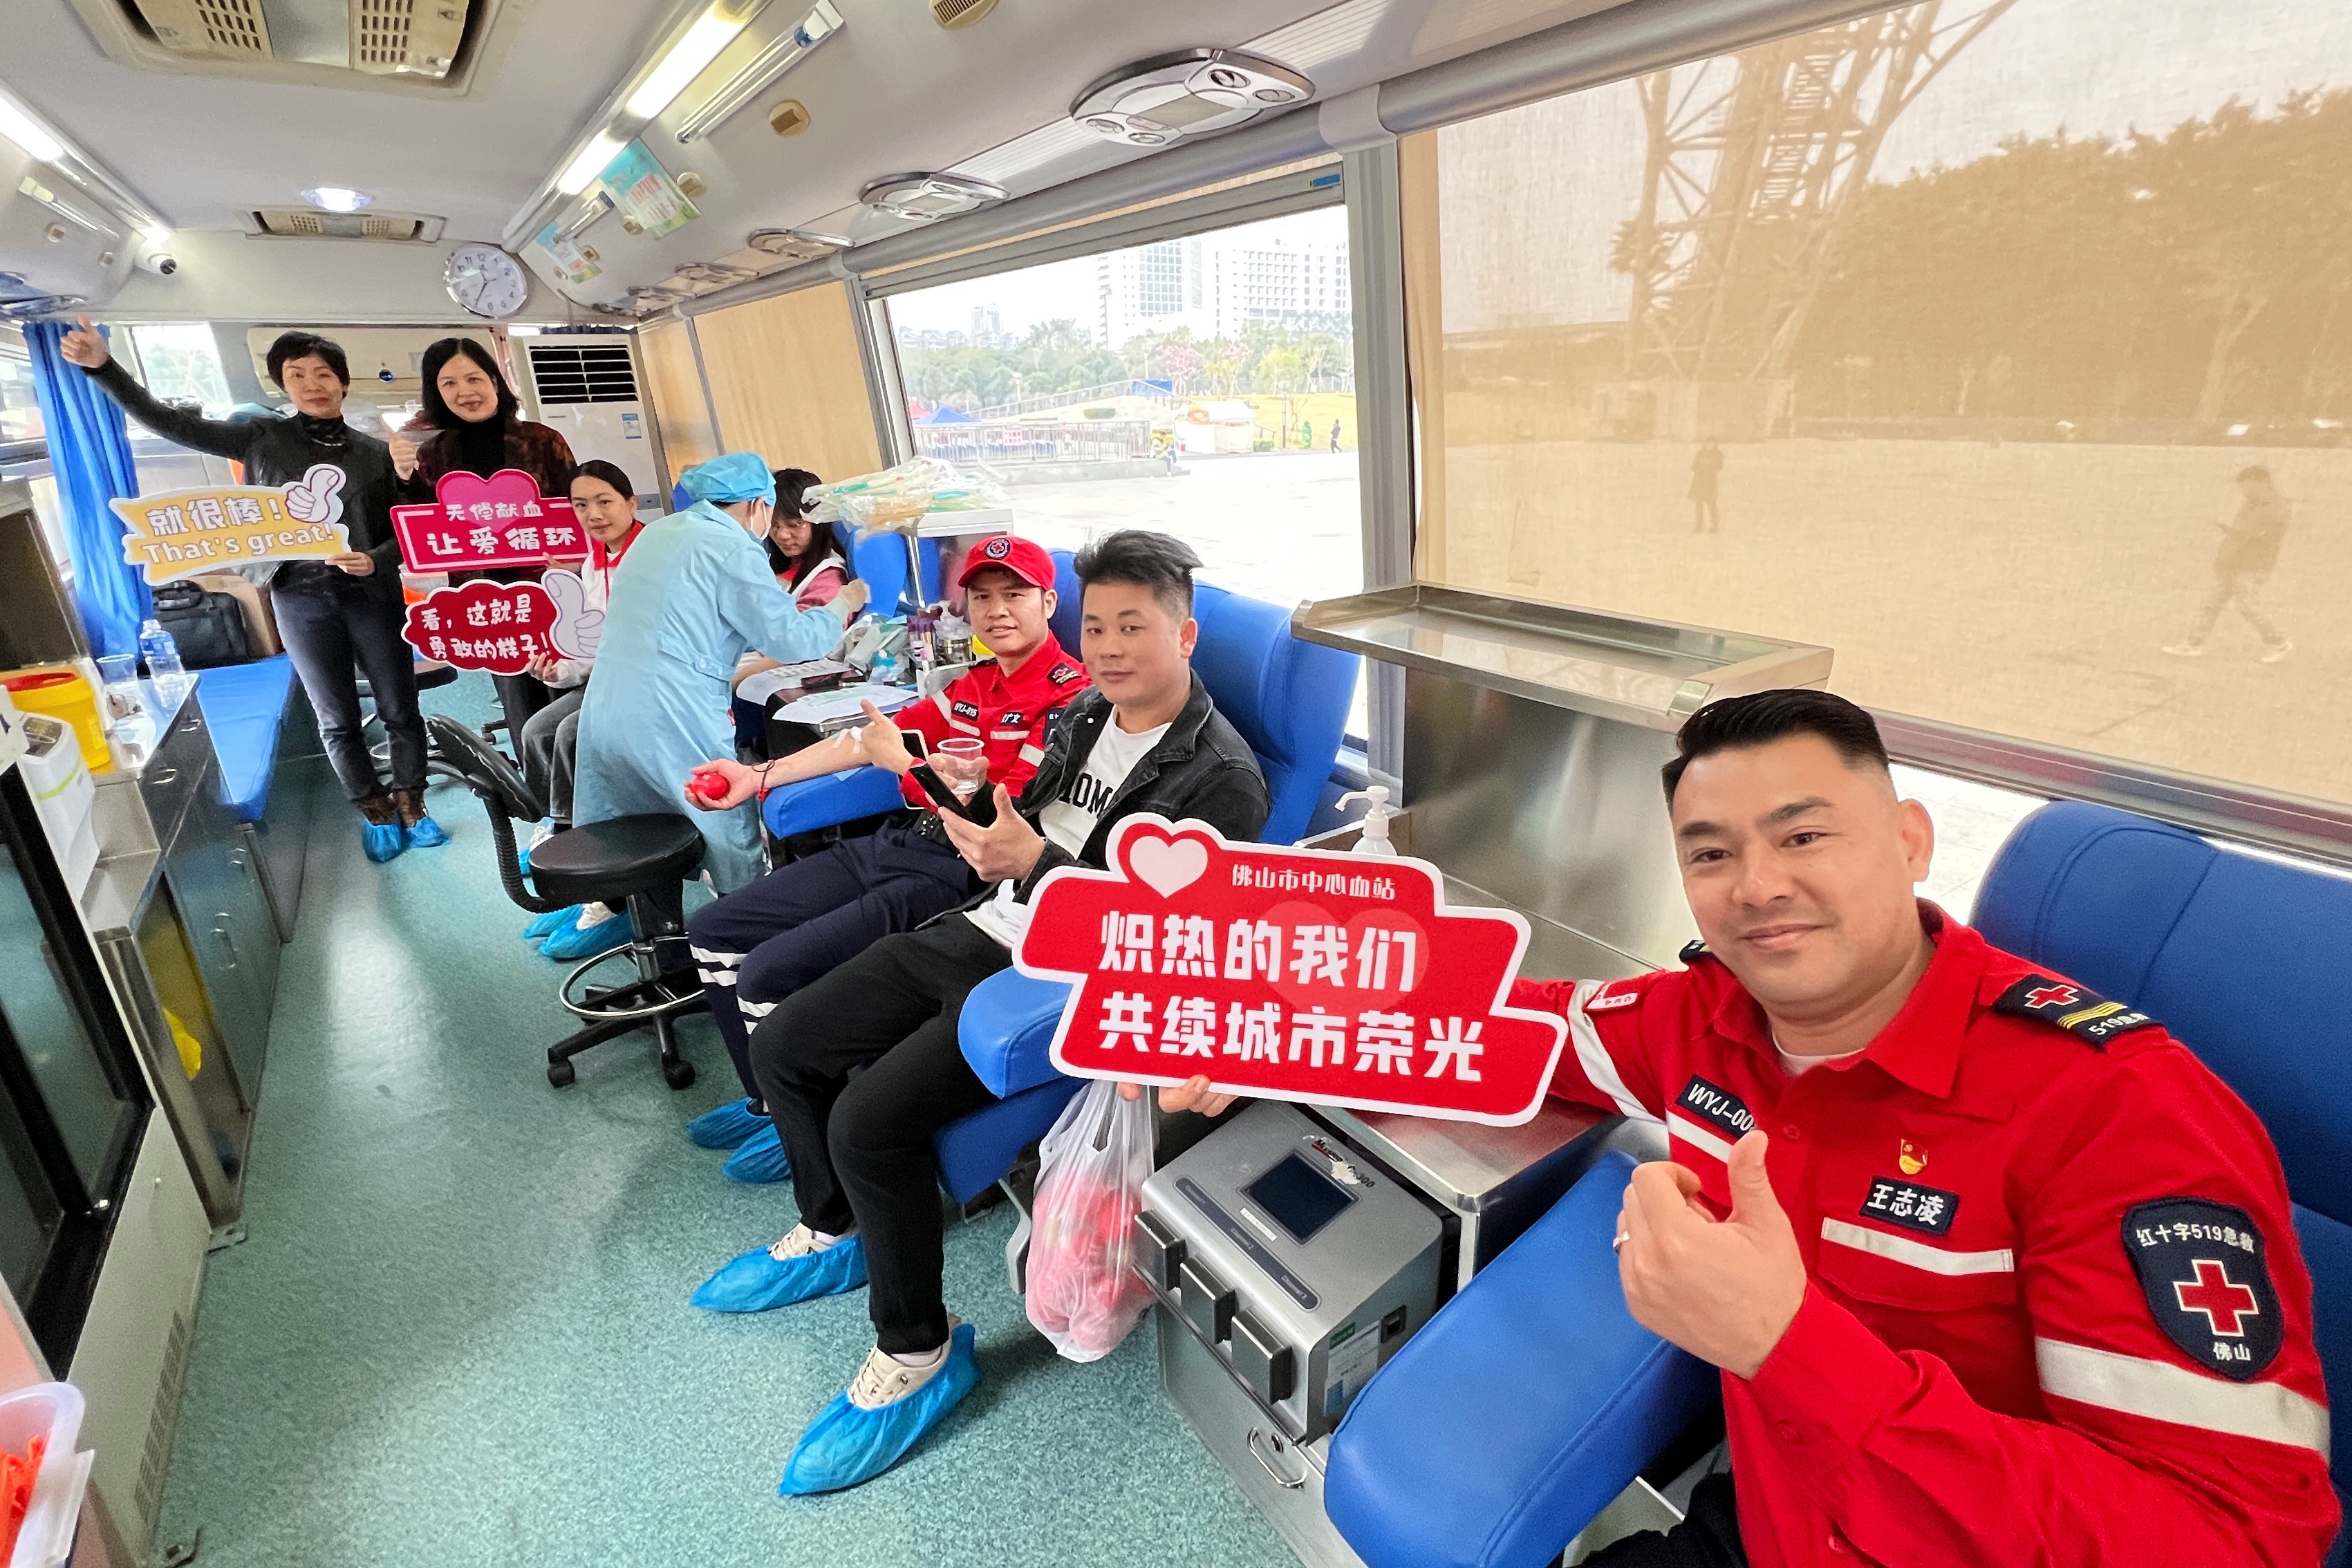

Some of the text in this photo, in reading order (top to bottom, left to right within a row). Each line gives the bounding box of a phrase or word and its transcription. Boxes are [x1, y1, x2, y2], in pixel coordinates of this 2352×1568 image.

[147, 496, 282, 536] 就很棒！
[446, 500, 544, 521] 无偿献血
[142, 523, 335, 564] That's great!
[427, 526, 577, 556] 让爱循环
[420, 593, 532, 631] 看，这就是
[429, 631, 551, 660] 勇敢的样子！
[1231, 864, 1397, 901] 佛山市中心血站
[1098, 910, 1417, 993] 炽热的我们
[1099, 991, 1484, 1082] 共续城市荣光
[1867, 1184, 1944, 1226] 王志凌
[2212, 1341, 2252, 1361] 佛山
